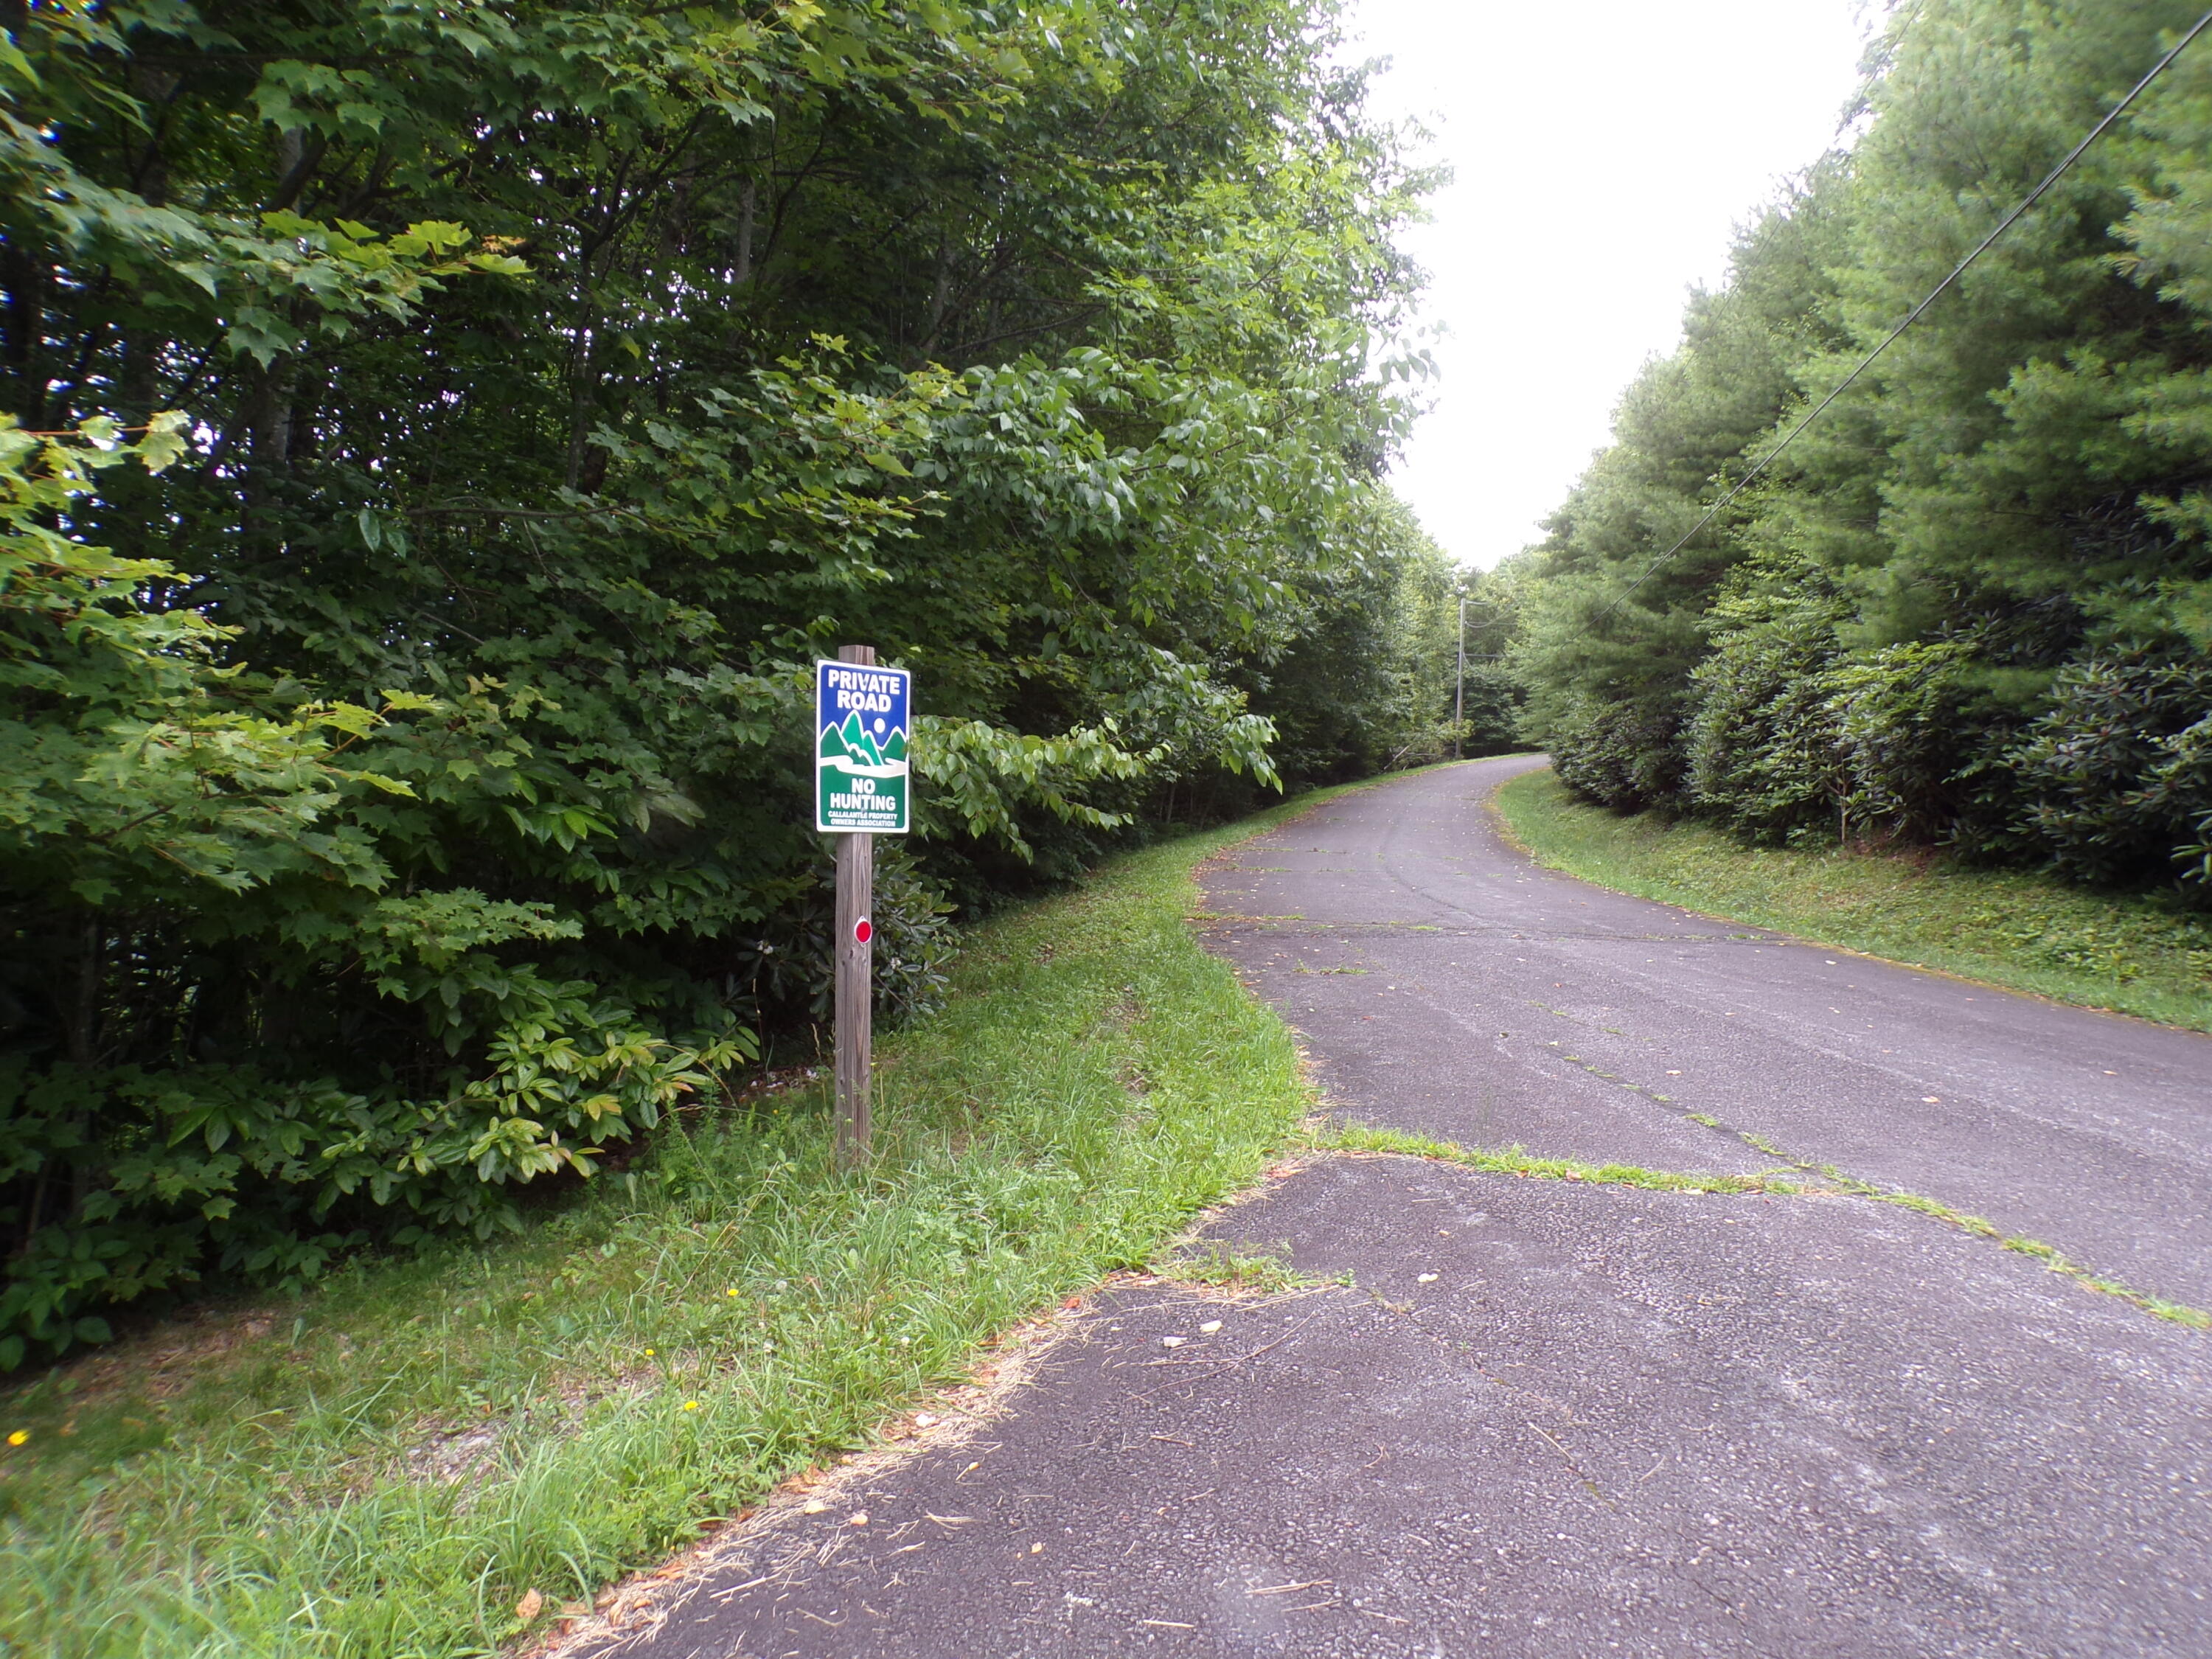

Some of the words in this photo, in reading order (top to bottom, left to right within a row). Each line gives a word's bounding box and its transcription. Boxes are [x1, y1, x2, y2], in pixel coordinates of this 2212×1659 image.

[828, 669, 900, 695] PRIVATE
[837, 689, 891, 712] ROAD
[852, 778, 875, 794] NO
[830, 793, 896, 811] HUNTING
[869, 813, 898, 821] PROPERTY
